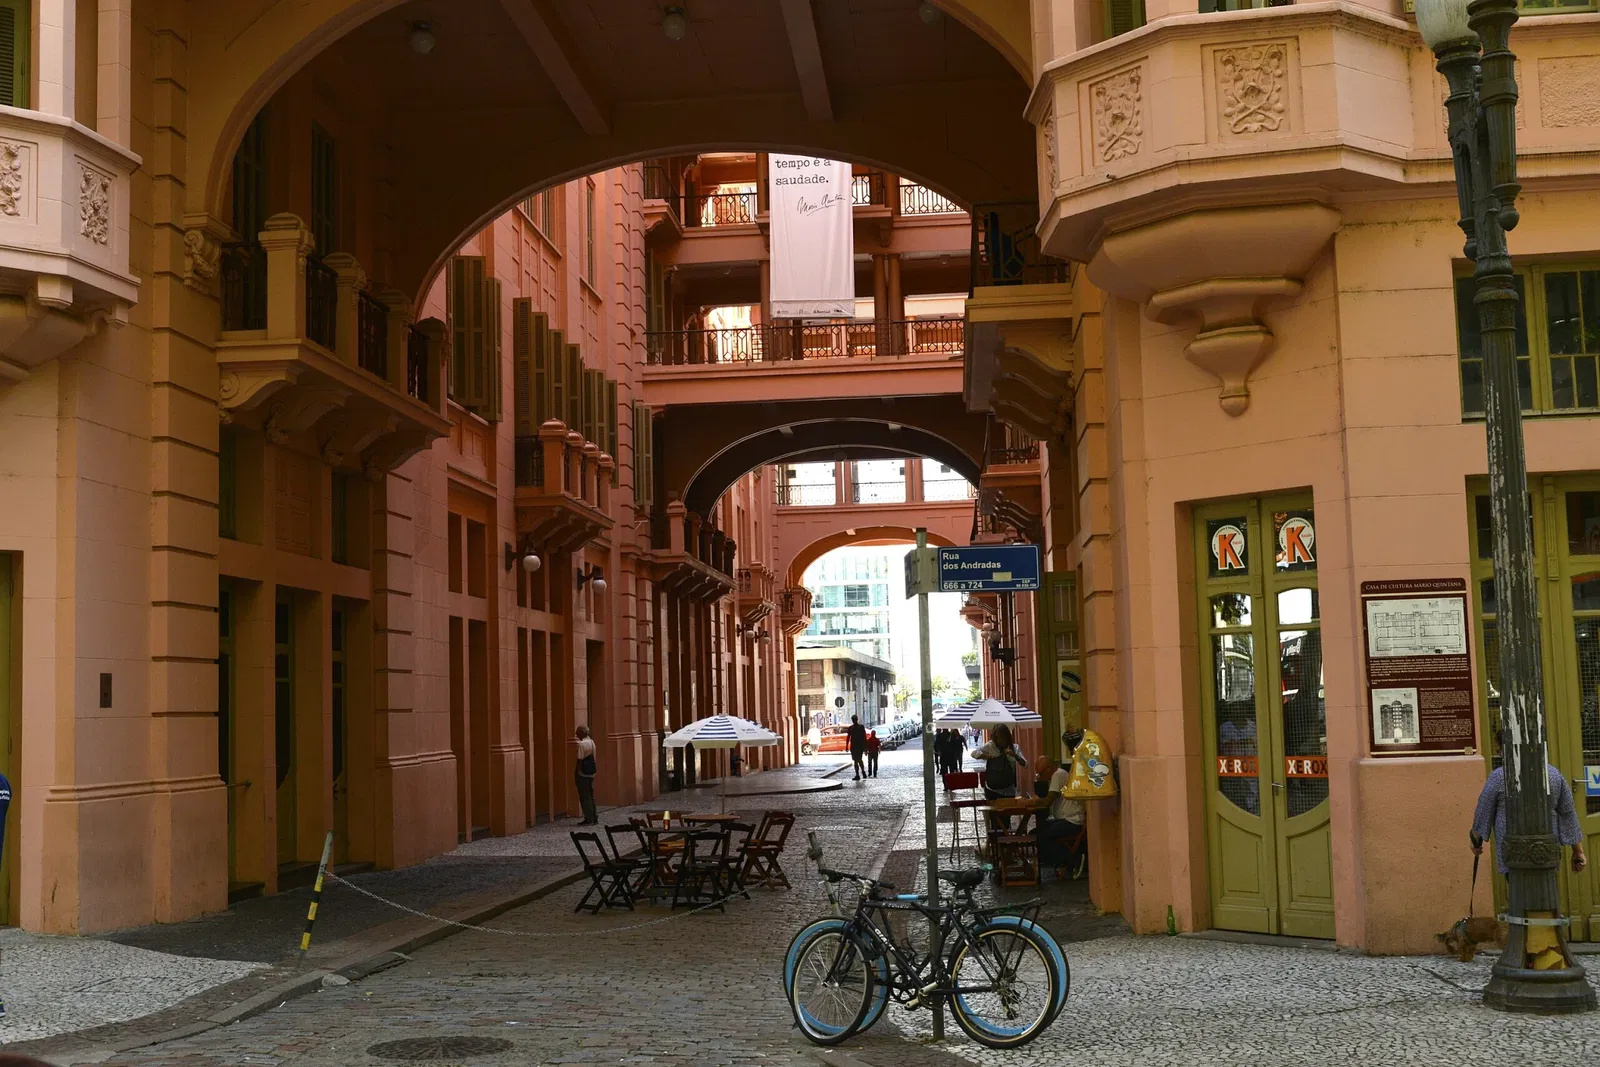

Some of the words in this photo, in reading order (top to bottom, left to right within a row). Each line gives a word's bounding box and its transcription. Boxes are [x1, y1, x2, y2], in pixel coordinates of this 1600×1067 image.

[775, 159, 810, 170] tempo
[813, 157, 820, 167] é
[775, 174, 829, 186] saudade.
[1218, 532, 1243, 569] K
[1285, 525, 1314, 563] K
[942, 552, 960, 560] Rua
[942, 562, 959, 570] dos
[960, 561, 1001, 569] Andradas
[943, 581, 959, 590] 666
[968, 581, 983, 589] 724
[1219, 759, 1257, 774] XEROX
[1287, 759, 1329, 775] XEROX
